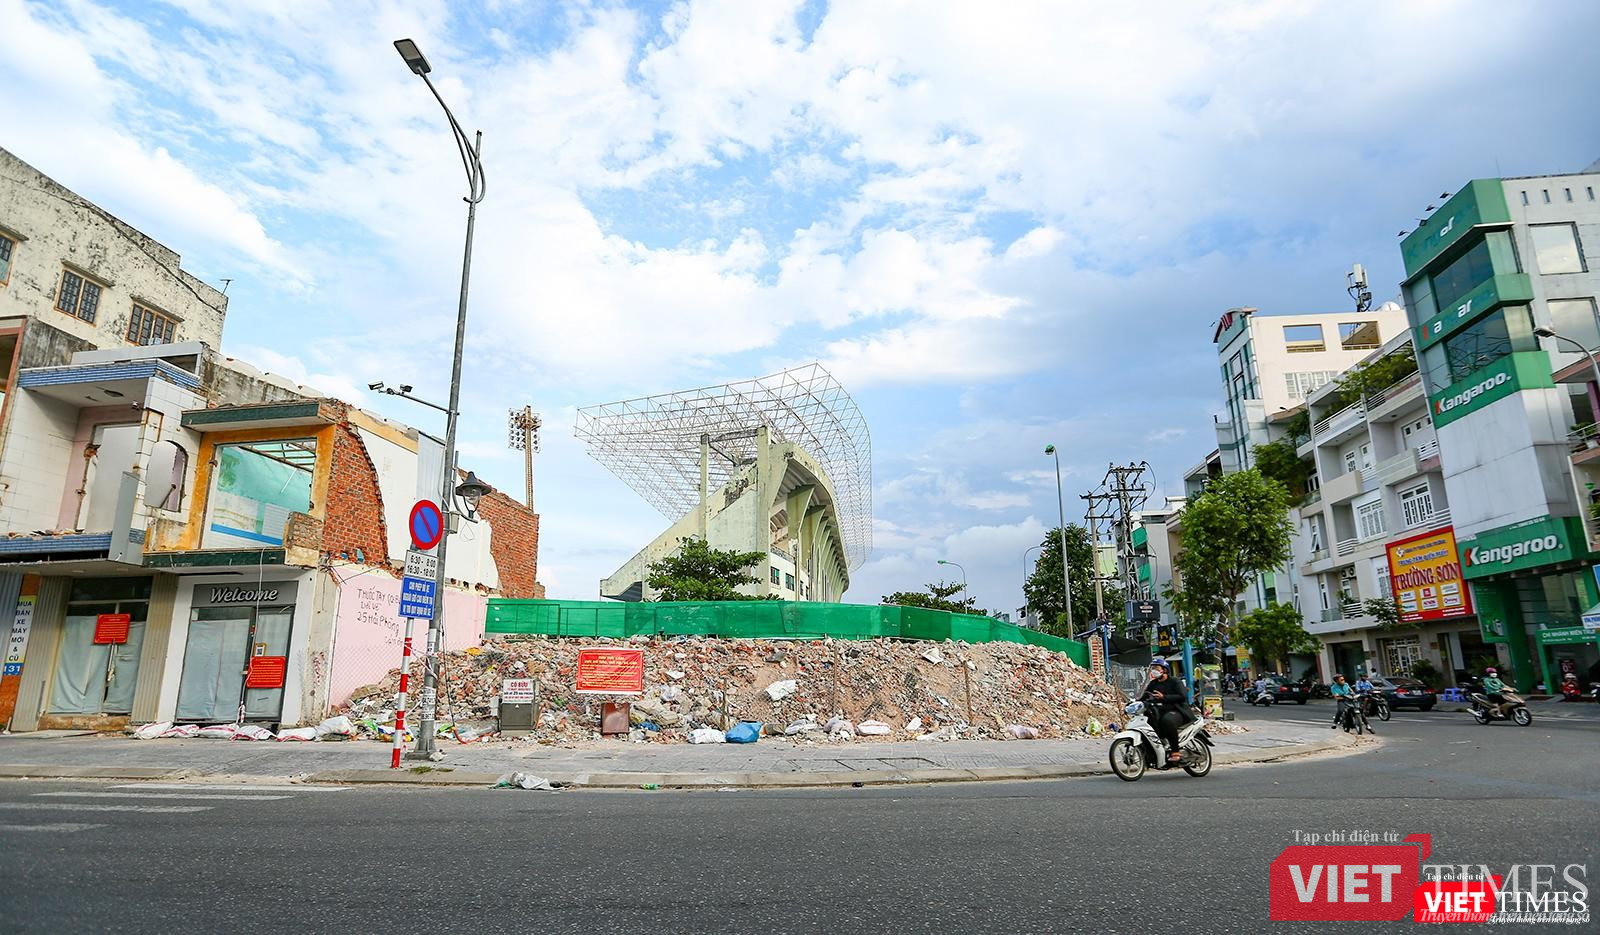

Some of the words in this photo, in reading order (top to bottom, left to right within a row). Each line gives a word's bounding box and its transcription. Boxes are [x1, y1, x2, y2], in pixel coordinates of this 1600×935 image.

[1394, 565, 1434, 590] TRƯỜNG
[1436, 561, 1458, 582] SƠN
[210, 587, 278, 602] Welcome
[357, 611, 367, 623] 25
